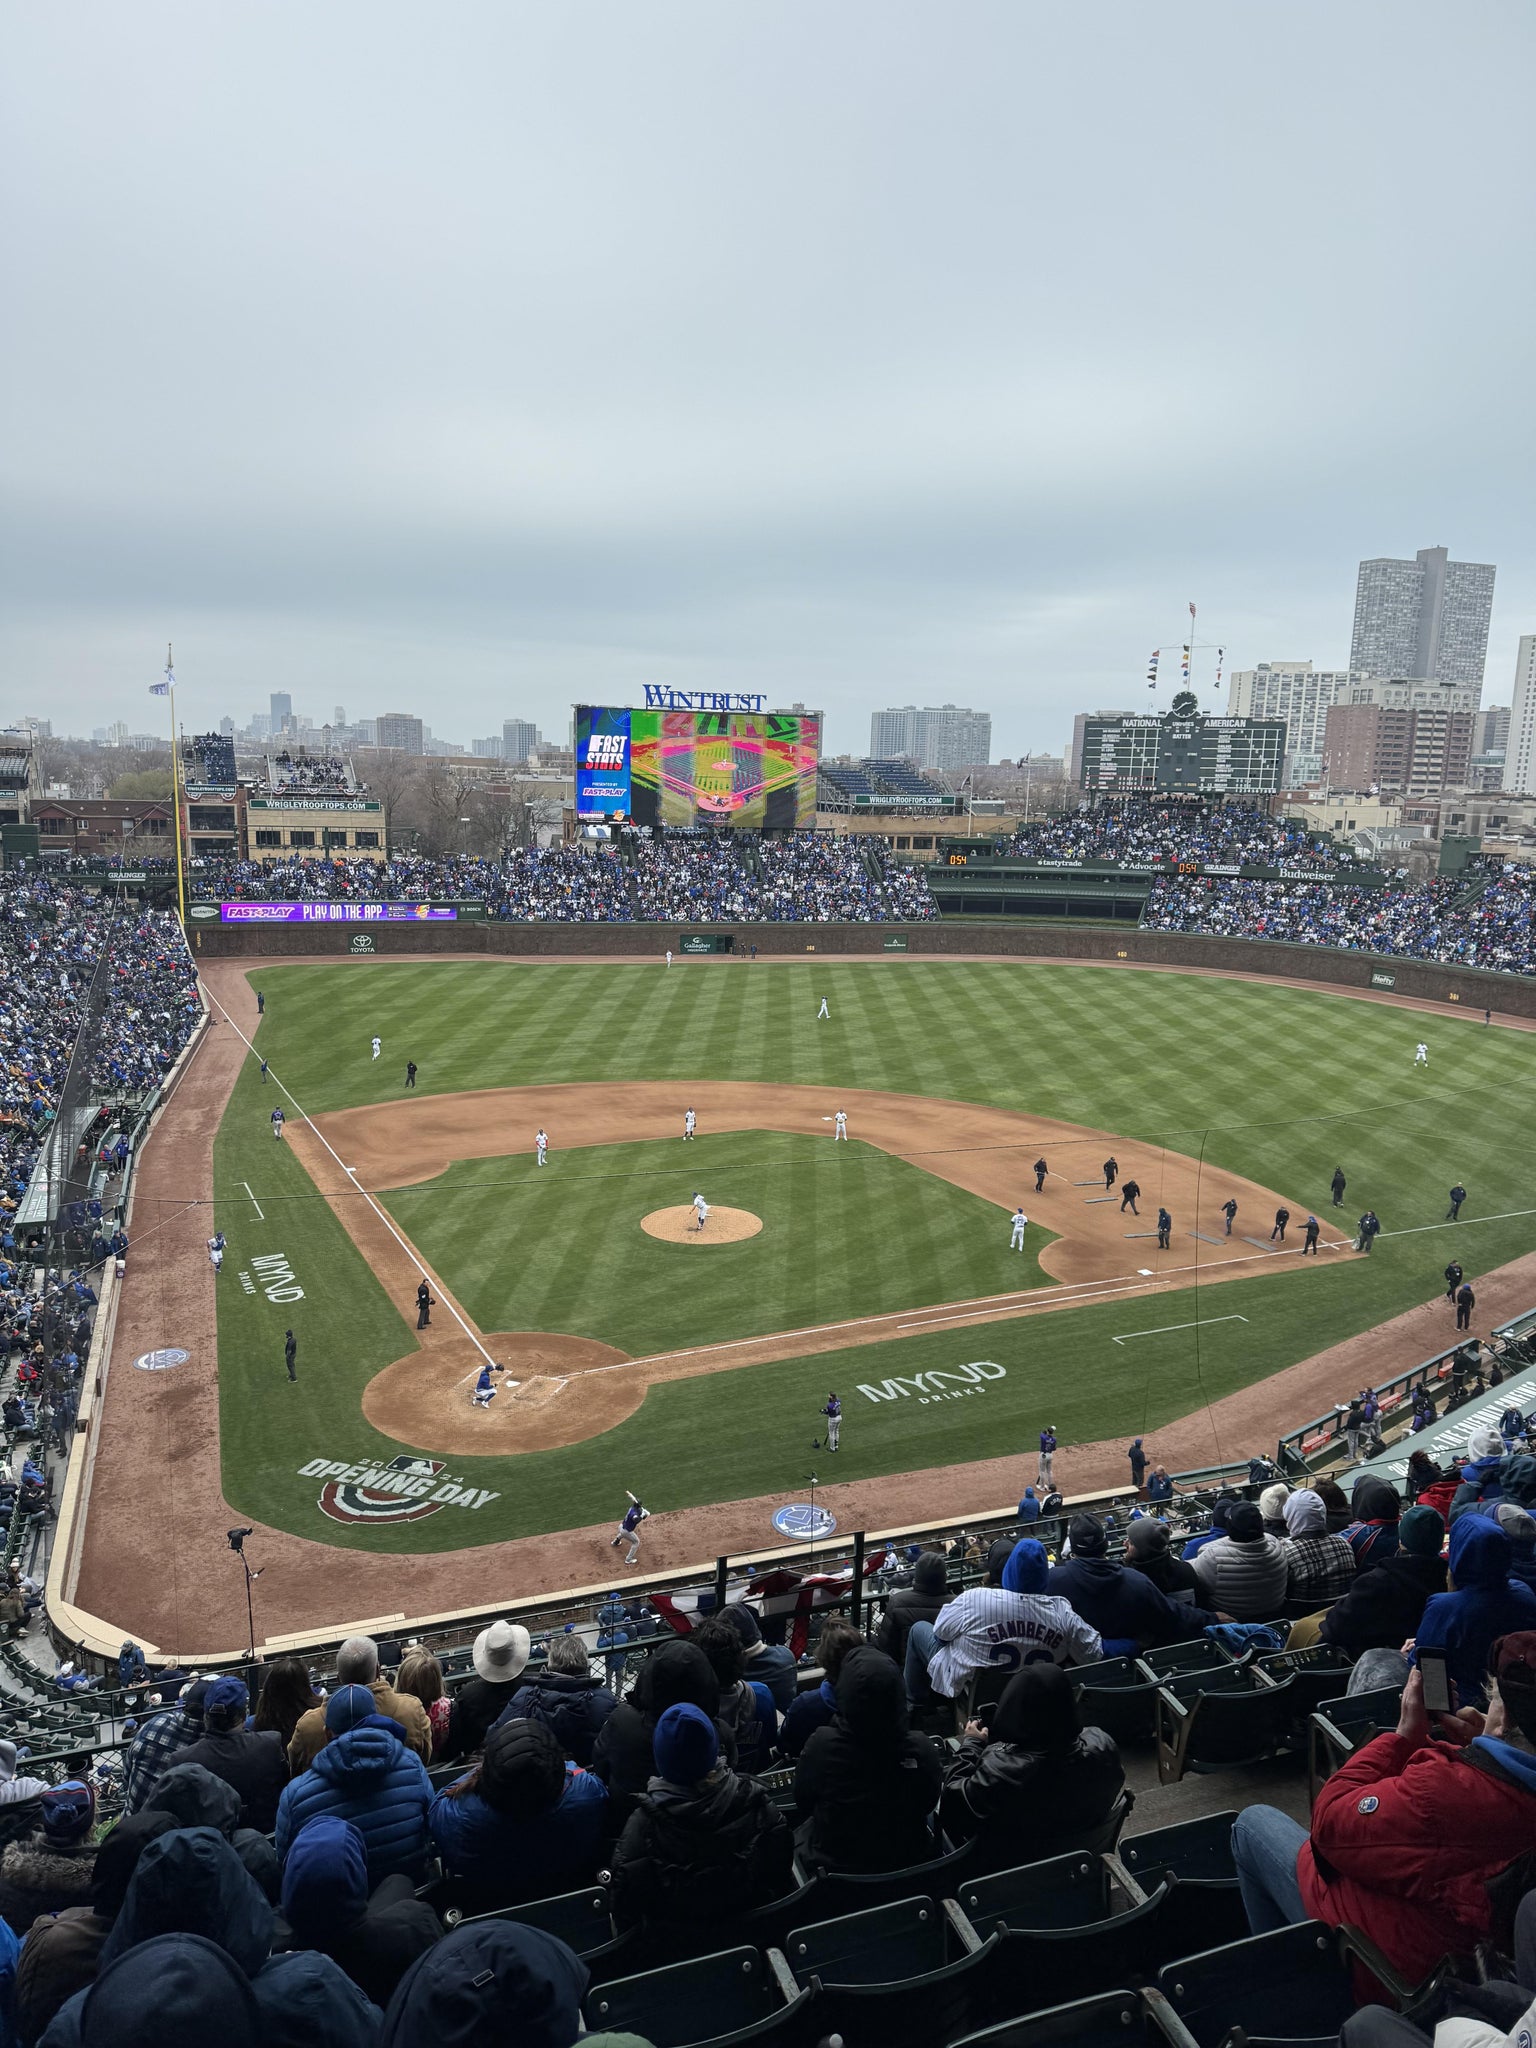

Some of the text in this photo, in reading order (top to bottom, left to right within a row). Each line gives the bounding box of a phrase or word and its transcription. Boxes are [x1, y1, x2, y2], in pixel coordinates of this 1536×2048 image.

[642, 684, 767, 712] WINTRUST
[1122, 719, 1162, 727] NATIONAL
[1204, 719, 1247, 727] AMERICAN
[594, 735, 627, 752] FAST
[585, 752, 624, 770] STATS
[869, 796, 943, 804] WRIGLEYROOFTOPS.COM
[950, 855, 967, 865] 0:54
[1043, 860, 1082, 868] tastytrade
[1129, 862, 1165, 871] Advocate
[1204, 864, 1241, 872] GRAINGER
[1280, 868, 1336, 881] Budweiser
[303, 905, 327, 919] PLAY
[330, 905, 342, 919] ON
[344, 905, 362, 919] THE
[364, 905, 383, 918] APP
[1374, 975, 1393, 985] Hefty
[251, 1253, 305, 1303] MYND
[855, 1361, 1007, 1403] MYND
[918, 1386, 986, 1404] DRINKS
[1433, 1429, 1469, 1447] THE
[358, 1458, 465, 1483] 20 24
[297, 1458, 502, 1509] OPENING DAY
[986, 1620, 1064, 1649] SANDBERG
